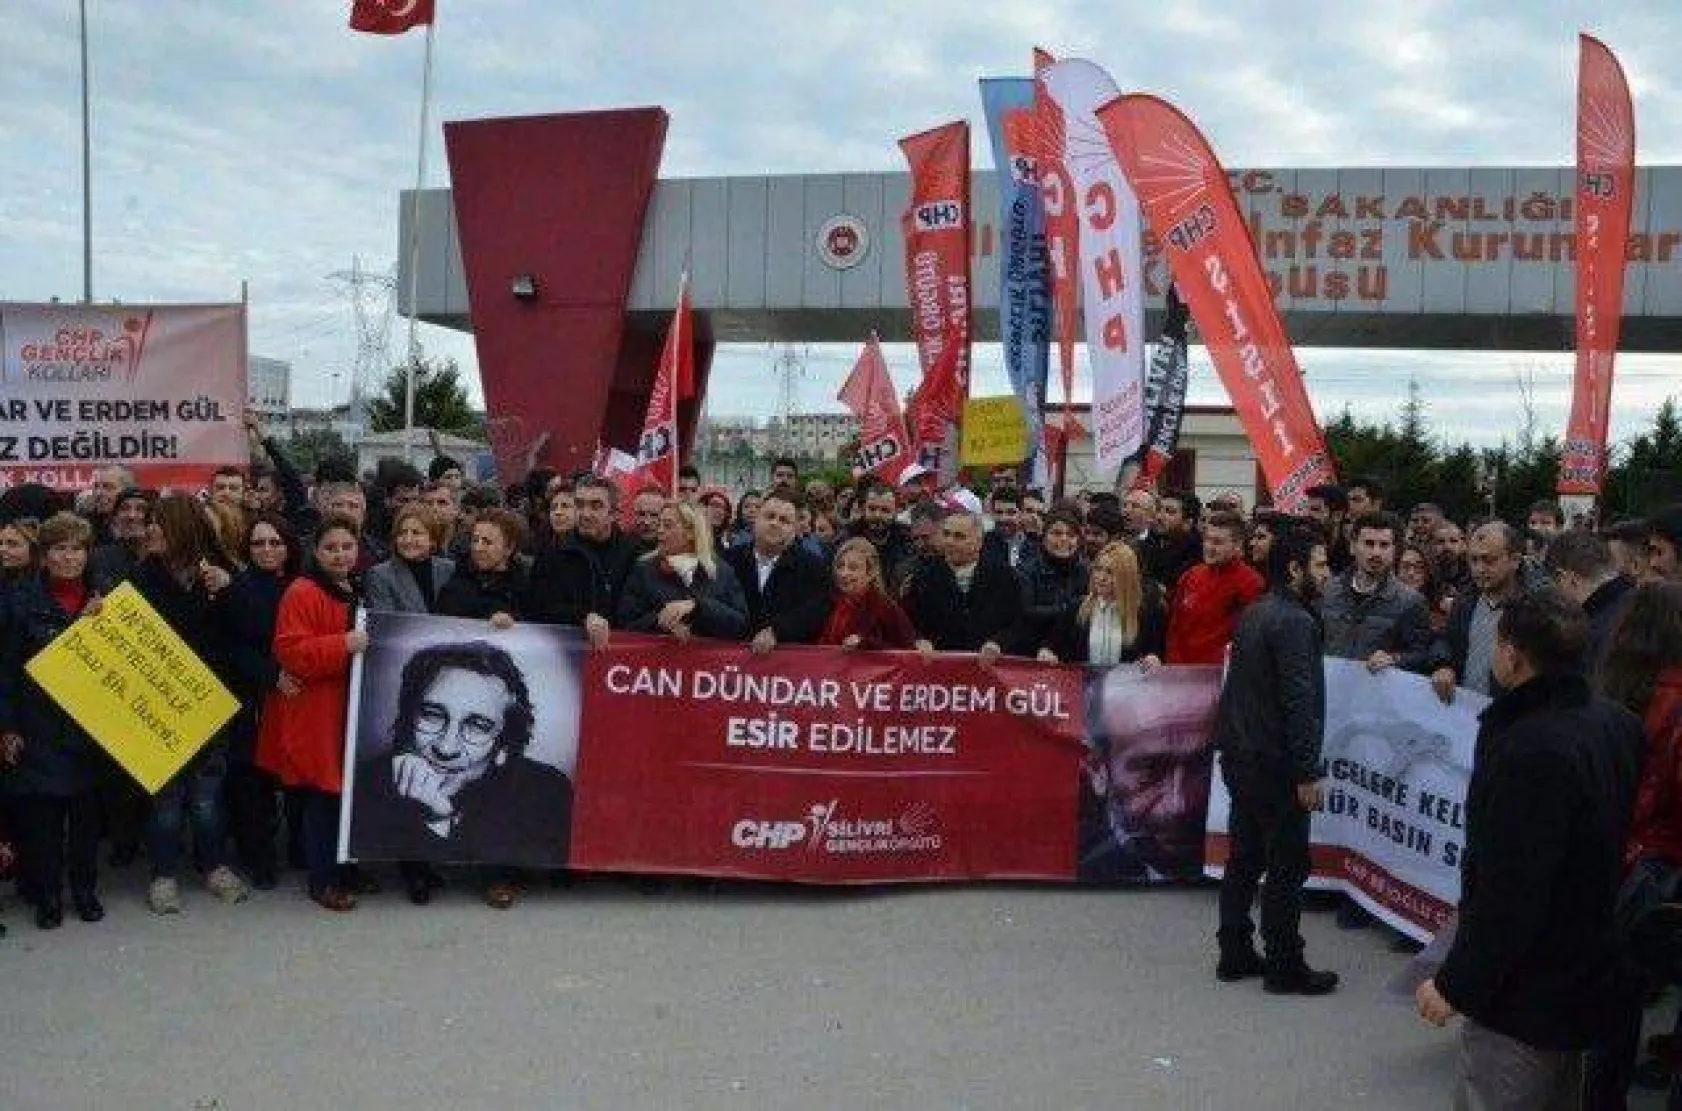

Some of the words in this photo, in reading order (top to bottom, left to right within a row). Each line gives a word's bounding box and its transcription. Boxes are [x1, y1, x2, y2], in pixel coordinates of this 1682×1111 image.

[33, 399, 72, 421] VE
[79, 399, 170, 421] ERDEM
[176, 394, 226, 422] GÜL
[28, 430, 177, 461] DEĞİLDİR!
[605, 664, 683, 698] CAN
[692, 665, 842, 709] DÜNDAR
[850, 682, 893, 711] VE
[899, 684, 996, 712] ERDEM
[1005, 684, 1070, 720] GÜL
[726, 712, 799, 749] ESİR
[810, 719, 957, 755] EDİLEMEZ
[732, 820, 806, 849] CHP
